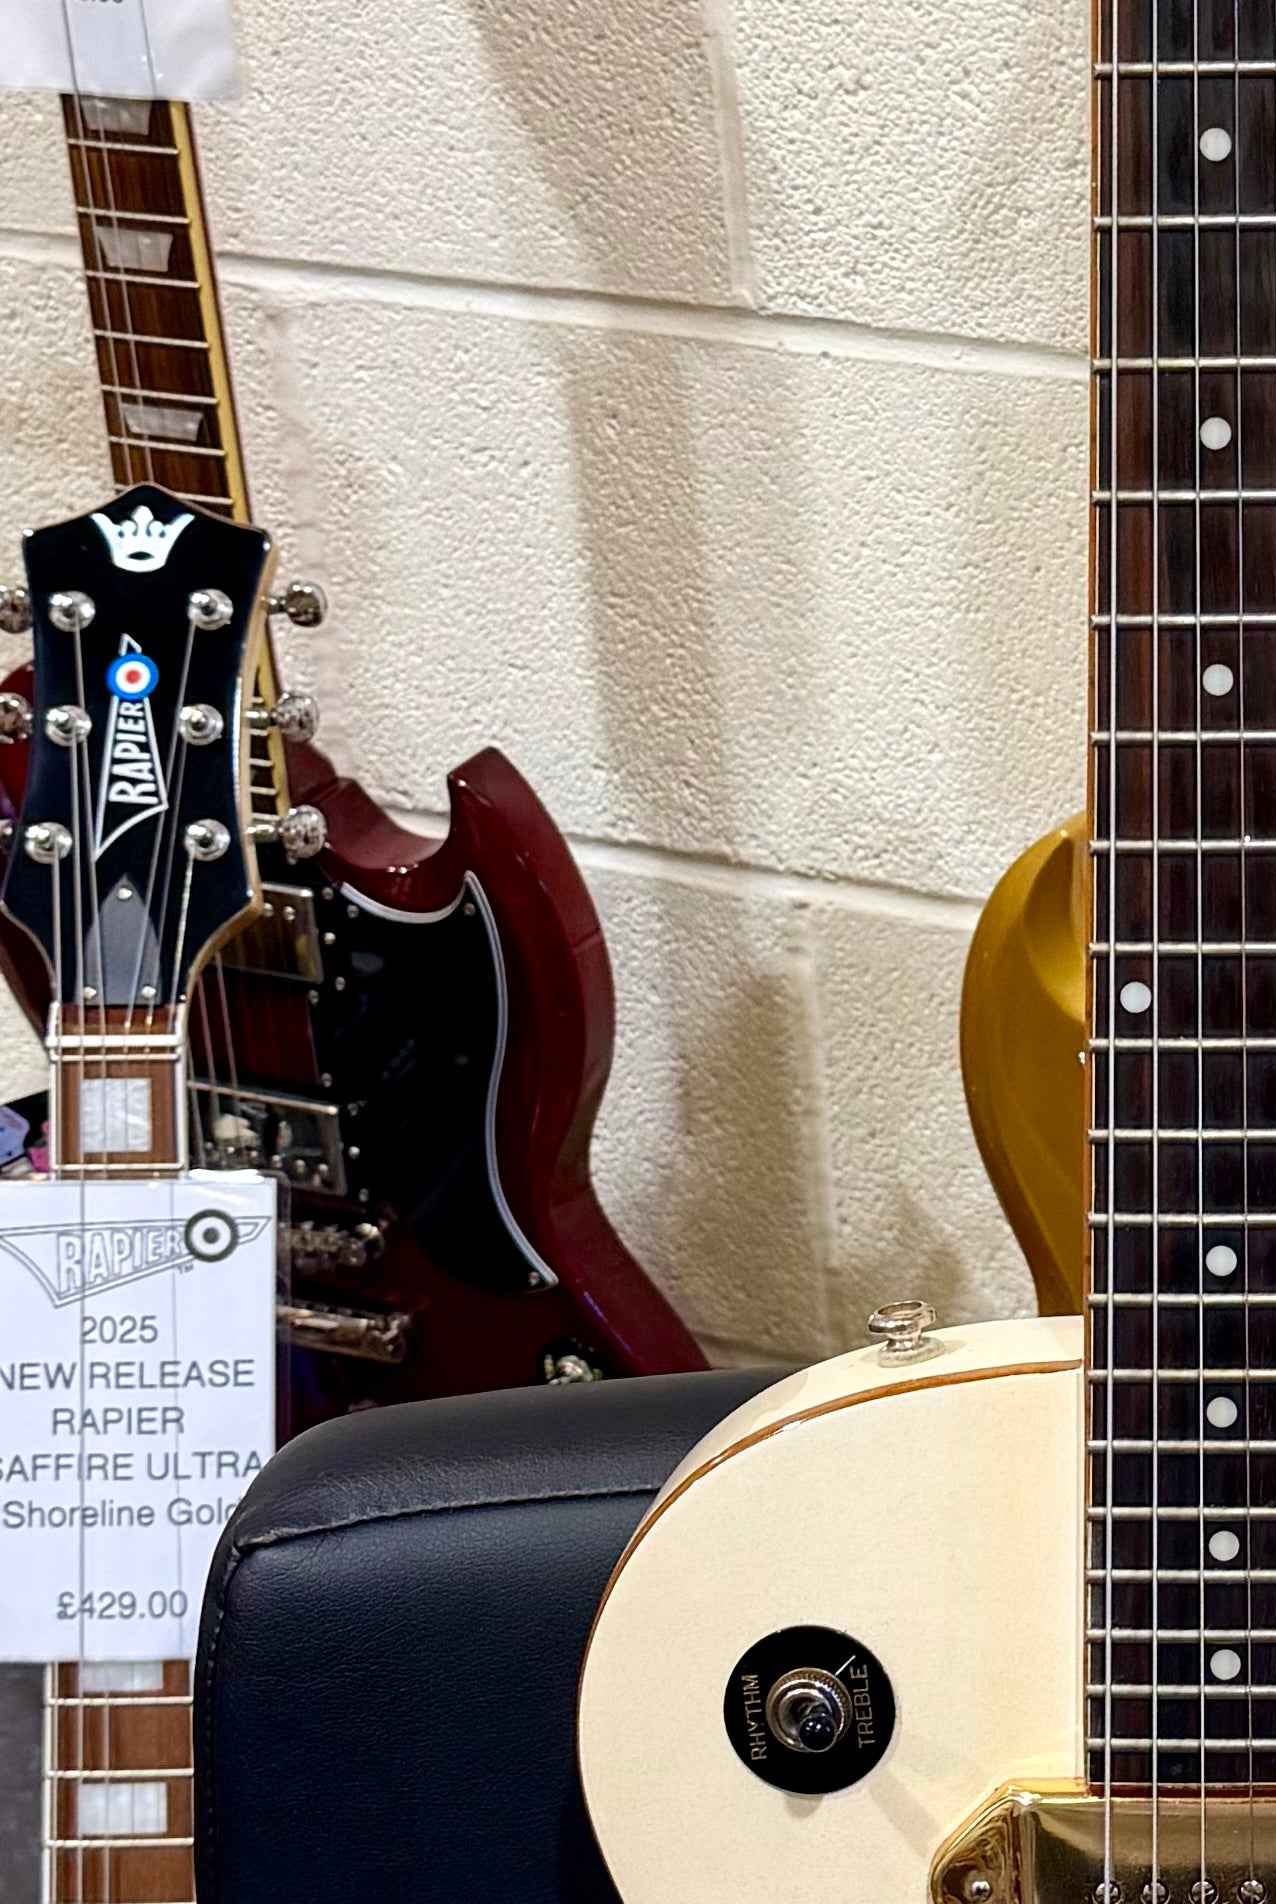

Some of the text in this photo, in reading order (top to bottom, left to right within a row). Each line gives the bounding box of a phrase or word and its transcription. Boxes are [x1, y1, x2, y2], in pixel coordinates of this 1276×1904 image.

[108, 696, 158, 806] RAPIER
[57, 1226, 182, 1294] RAPIER
[81, 1315, 159, 1345] 2025
[89, 1359, 255, 1389] RELEASE
[51, 1407, 185, 1436] RAPIER
[147, 1450, 262, 1481] ULTRA
[3, 1499, 155, 1529] Shoreline
[57, 1590, 188, 1622] £429.00
[741, 1673, 768, 1761] RHYTHM
[849, 1663, 876, 1749] TREBLE
